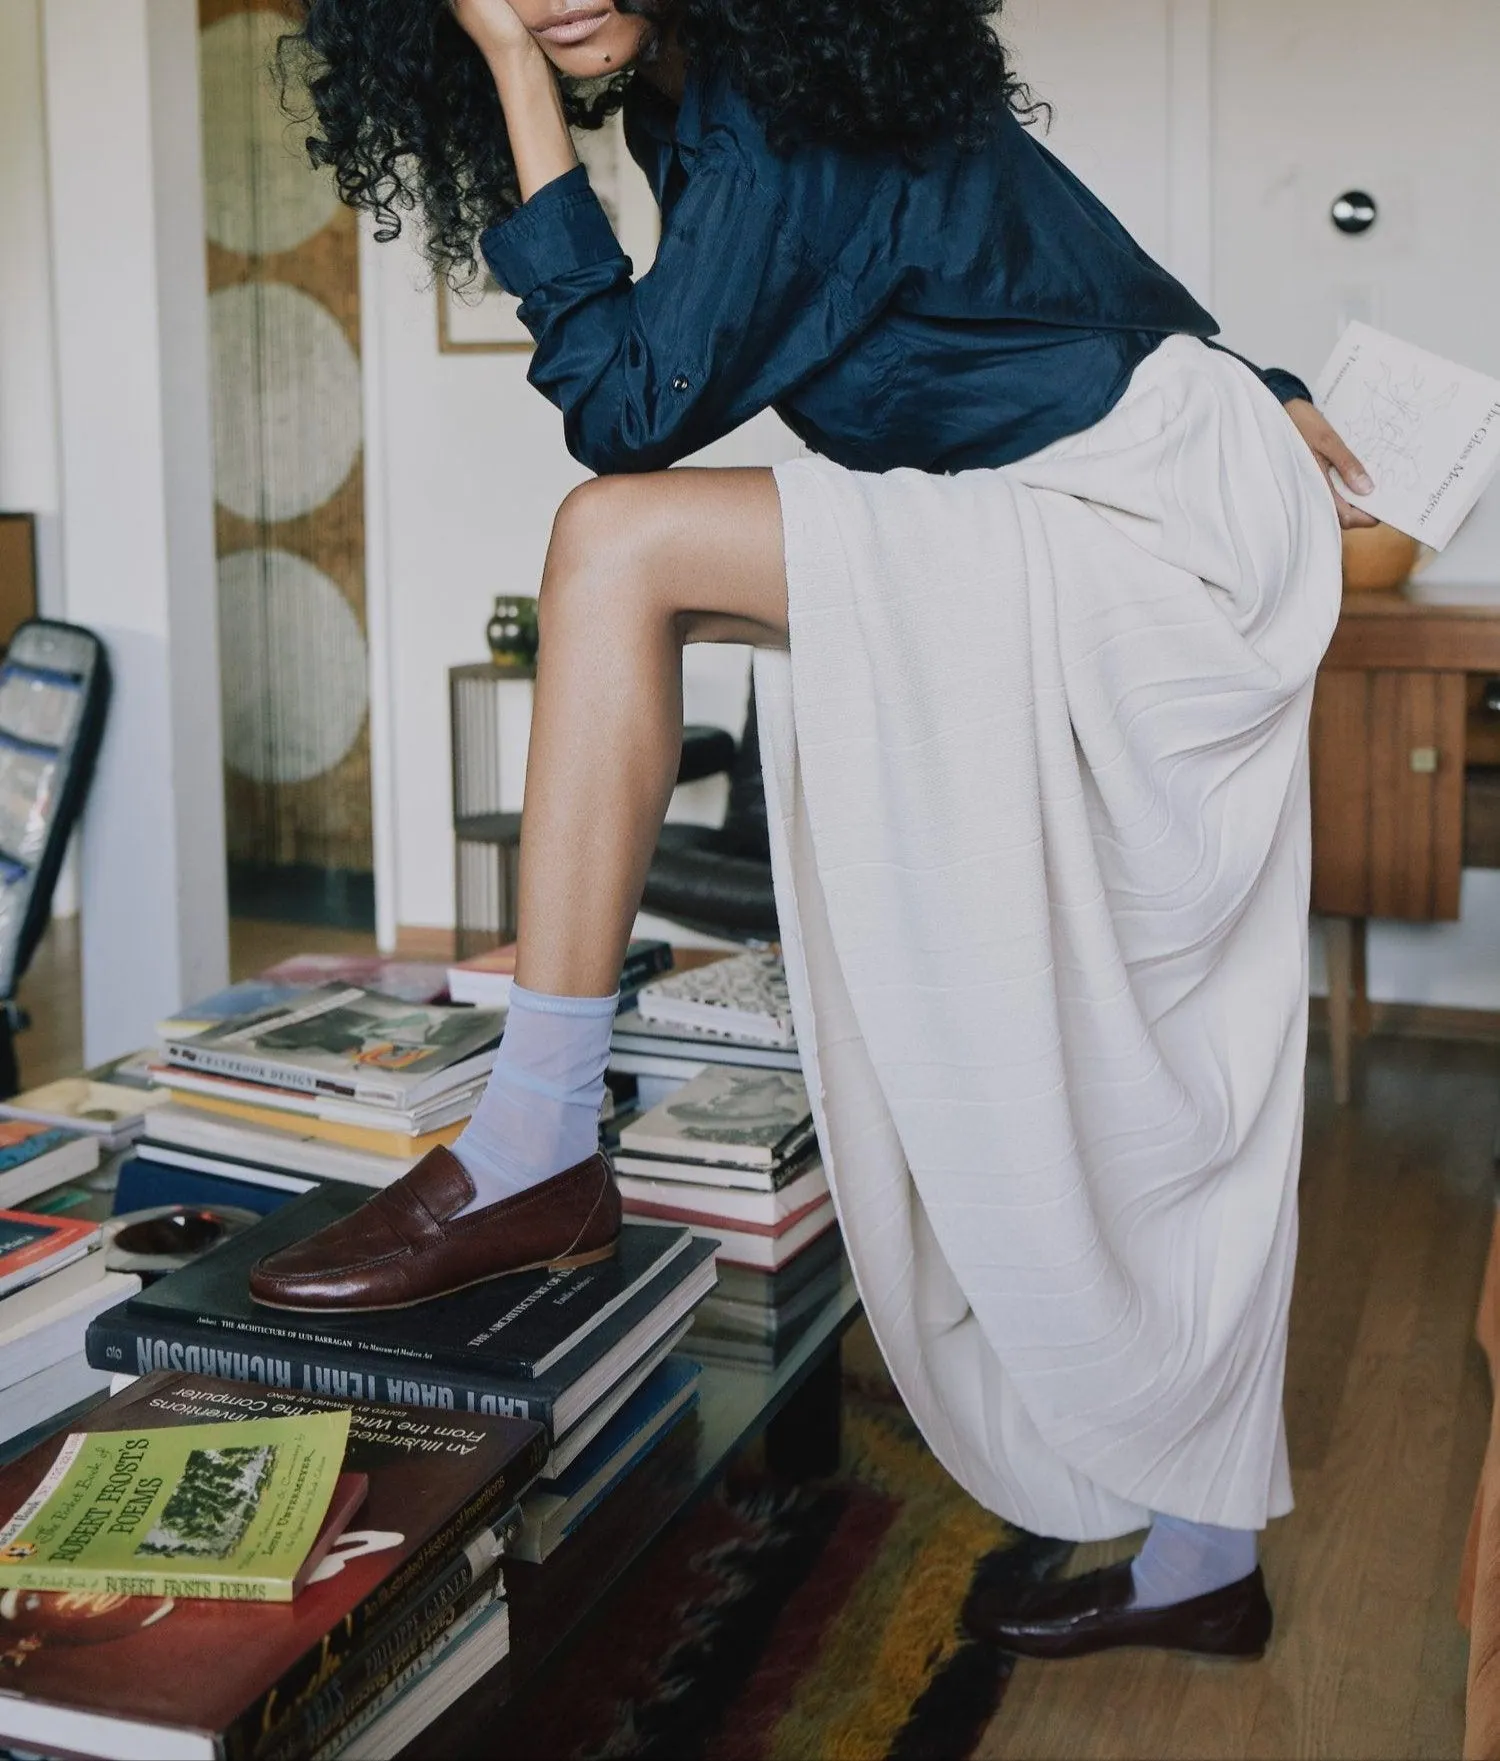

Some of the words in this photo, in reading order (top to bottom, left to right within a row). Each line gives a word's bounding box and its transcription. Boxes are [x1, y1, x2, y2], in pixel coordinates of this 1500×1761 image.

[1459, 428, 1486, 460] Glass
[1420, 463, 1463, 526] Menagerie
[222, 1320, 235, 1330] THE
[236, 1322, 287, 1338] ARCHITECTURE
[287, 1331, 297, 1340] OF
[298, 1332, 314, 1342] LUIS
[314, 1334, 353, 1348] BARRAGAN
[358, 1341, 369, 1350] The
[466, 1330, 493, 1347] THE
[136, 1336, 292, 1389] RICHARDSON
[302, 1363, 376, 1401] TERRY
[386, 1378, 454, 1410] GAGA
[172, 1387, 268, 1412] Computer
[266, 1391, 296, 1400] BONO
[298, 1395, 310, 1403] DE
[150, 1398, 249, 1423] Inventions
[272, 1403, 304, 1417] the
[357, 1405, 371, 1413] BY
[371, 1407, 408, 1418] EDITED
[350, 1415, 393, 1430] Whe
[397, 1421, 431, 1435] the
[433, 1427, 487, 1443] From
[446, 1443, 478, 1456] An
[75, 1462, 102, 1491] Book
[48, 1507, 113, 1563] ROBERT
[95, 1438, 150, 1504] FROST'S
[107, 1476, 163, 1535] POEMS
[104, 1576, 155, 1596] ROBERT
[218, 1581, 267, 1600] POEMS
